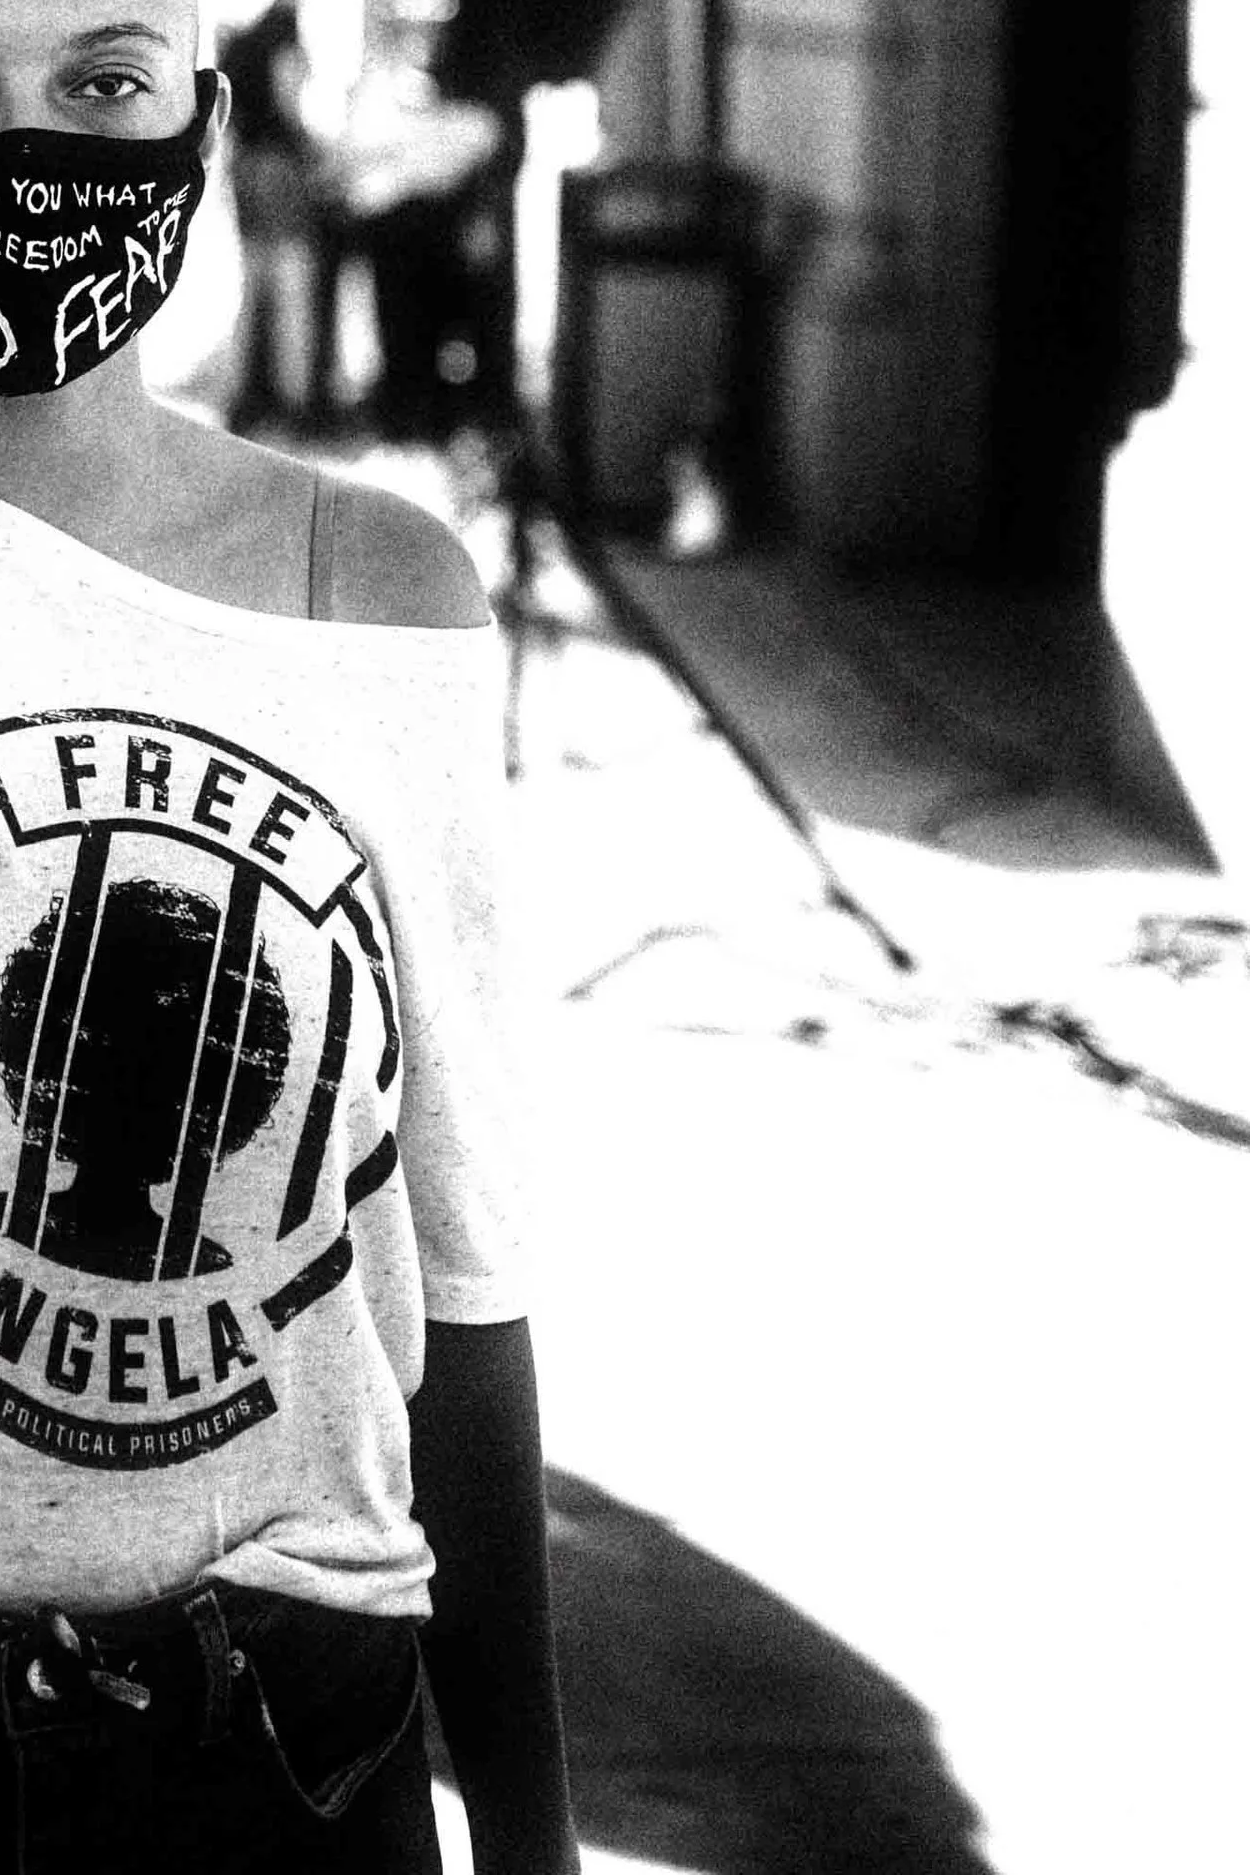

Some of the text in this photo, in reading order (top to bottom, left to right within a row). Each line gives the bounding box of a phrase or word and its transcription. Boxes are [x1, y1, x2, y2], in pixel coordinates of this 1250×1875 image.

[11, 177, 62, 214] YOU
[72, 181, 157, 208] WHAT
[136, 209, 161, 236] TO
[163, 183, 191, 214] ME
[54, 733, 311, 866] FREE
[1, 1397, 117, 1457] POLITICAL
